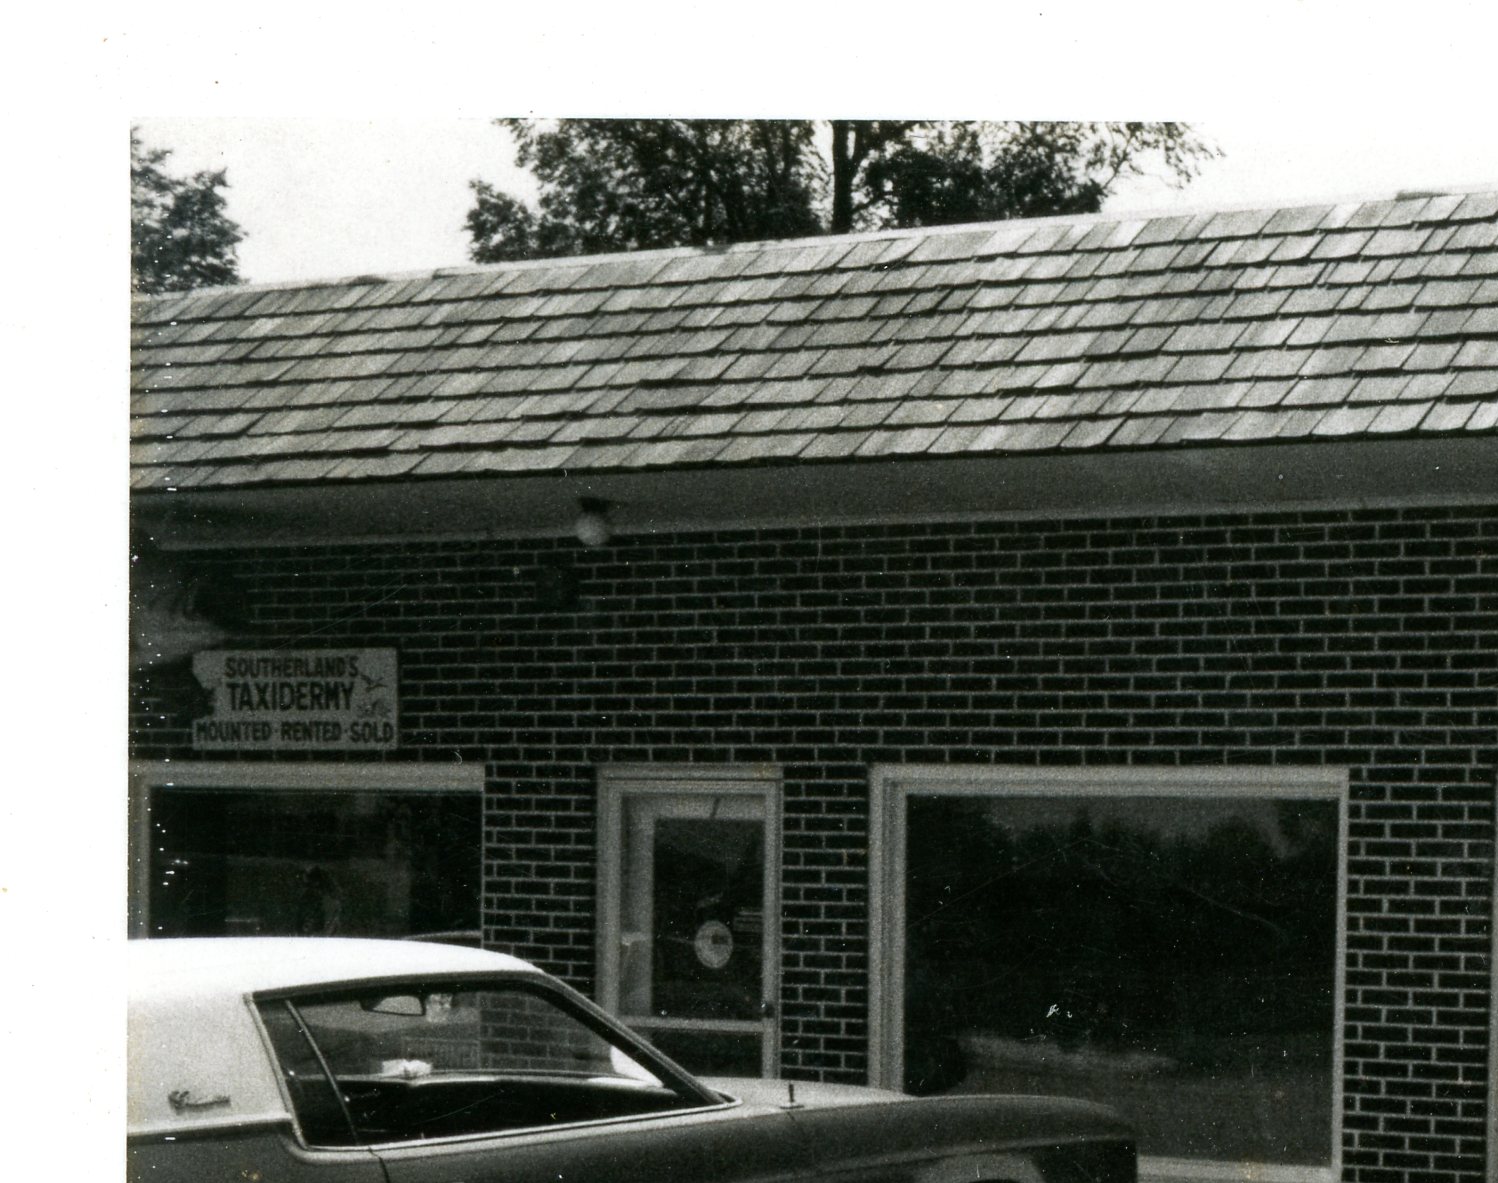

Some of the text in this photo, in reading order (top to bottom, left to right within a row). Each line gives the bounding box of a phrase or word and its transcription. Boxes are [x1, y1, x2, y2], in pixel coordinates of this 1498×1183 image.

[226, 681, 355, 711] TAXIDERMY
[196, 721, 394, 743] MOUNTED RENTED SOLD
